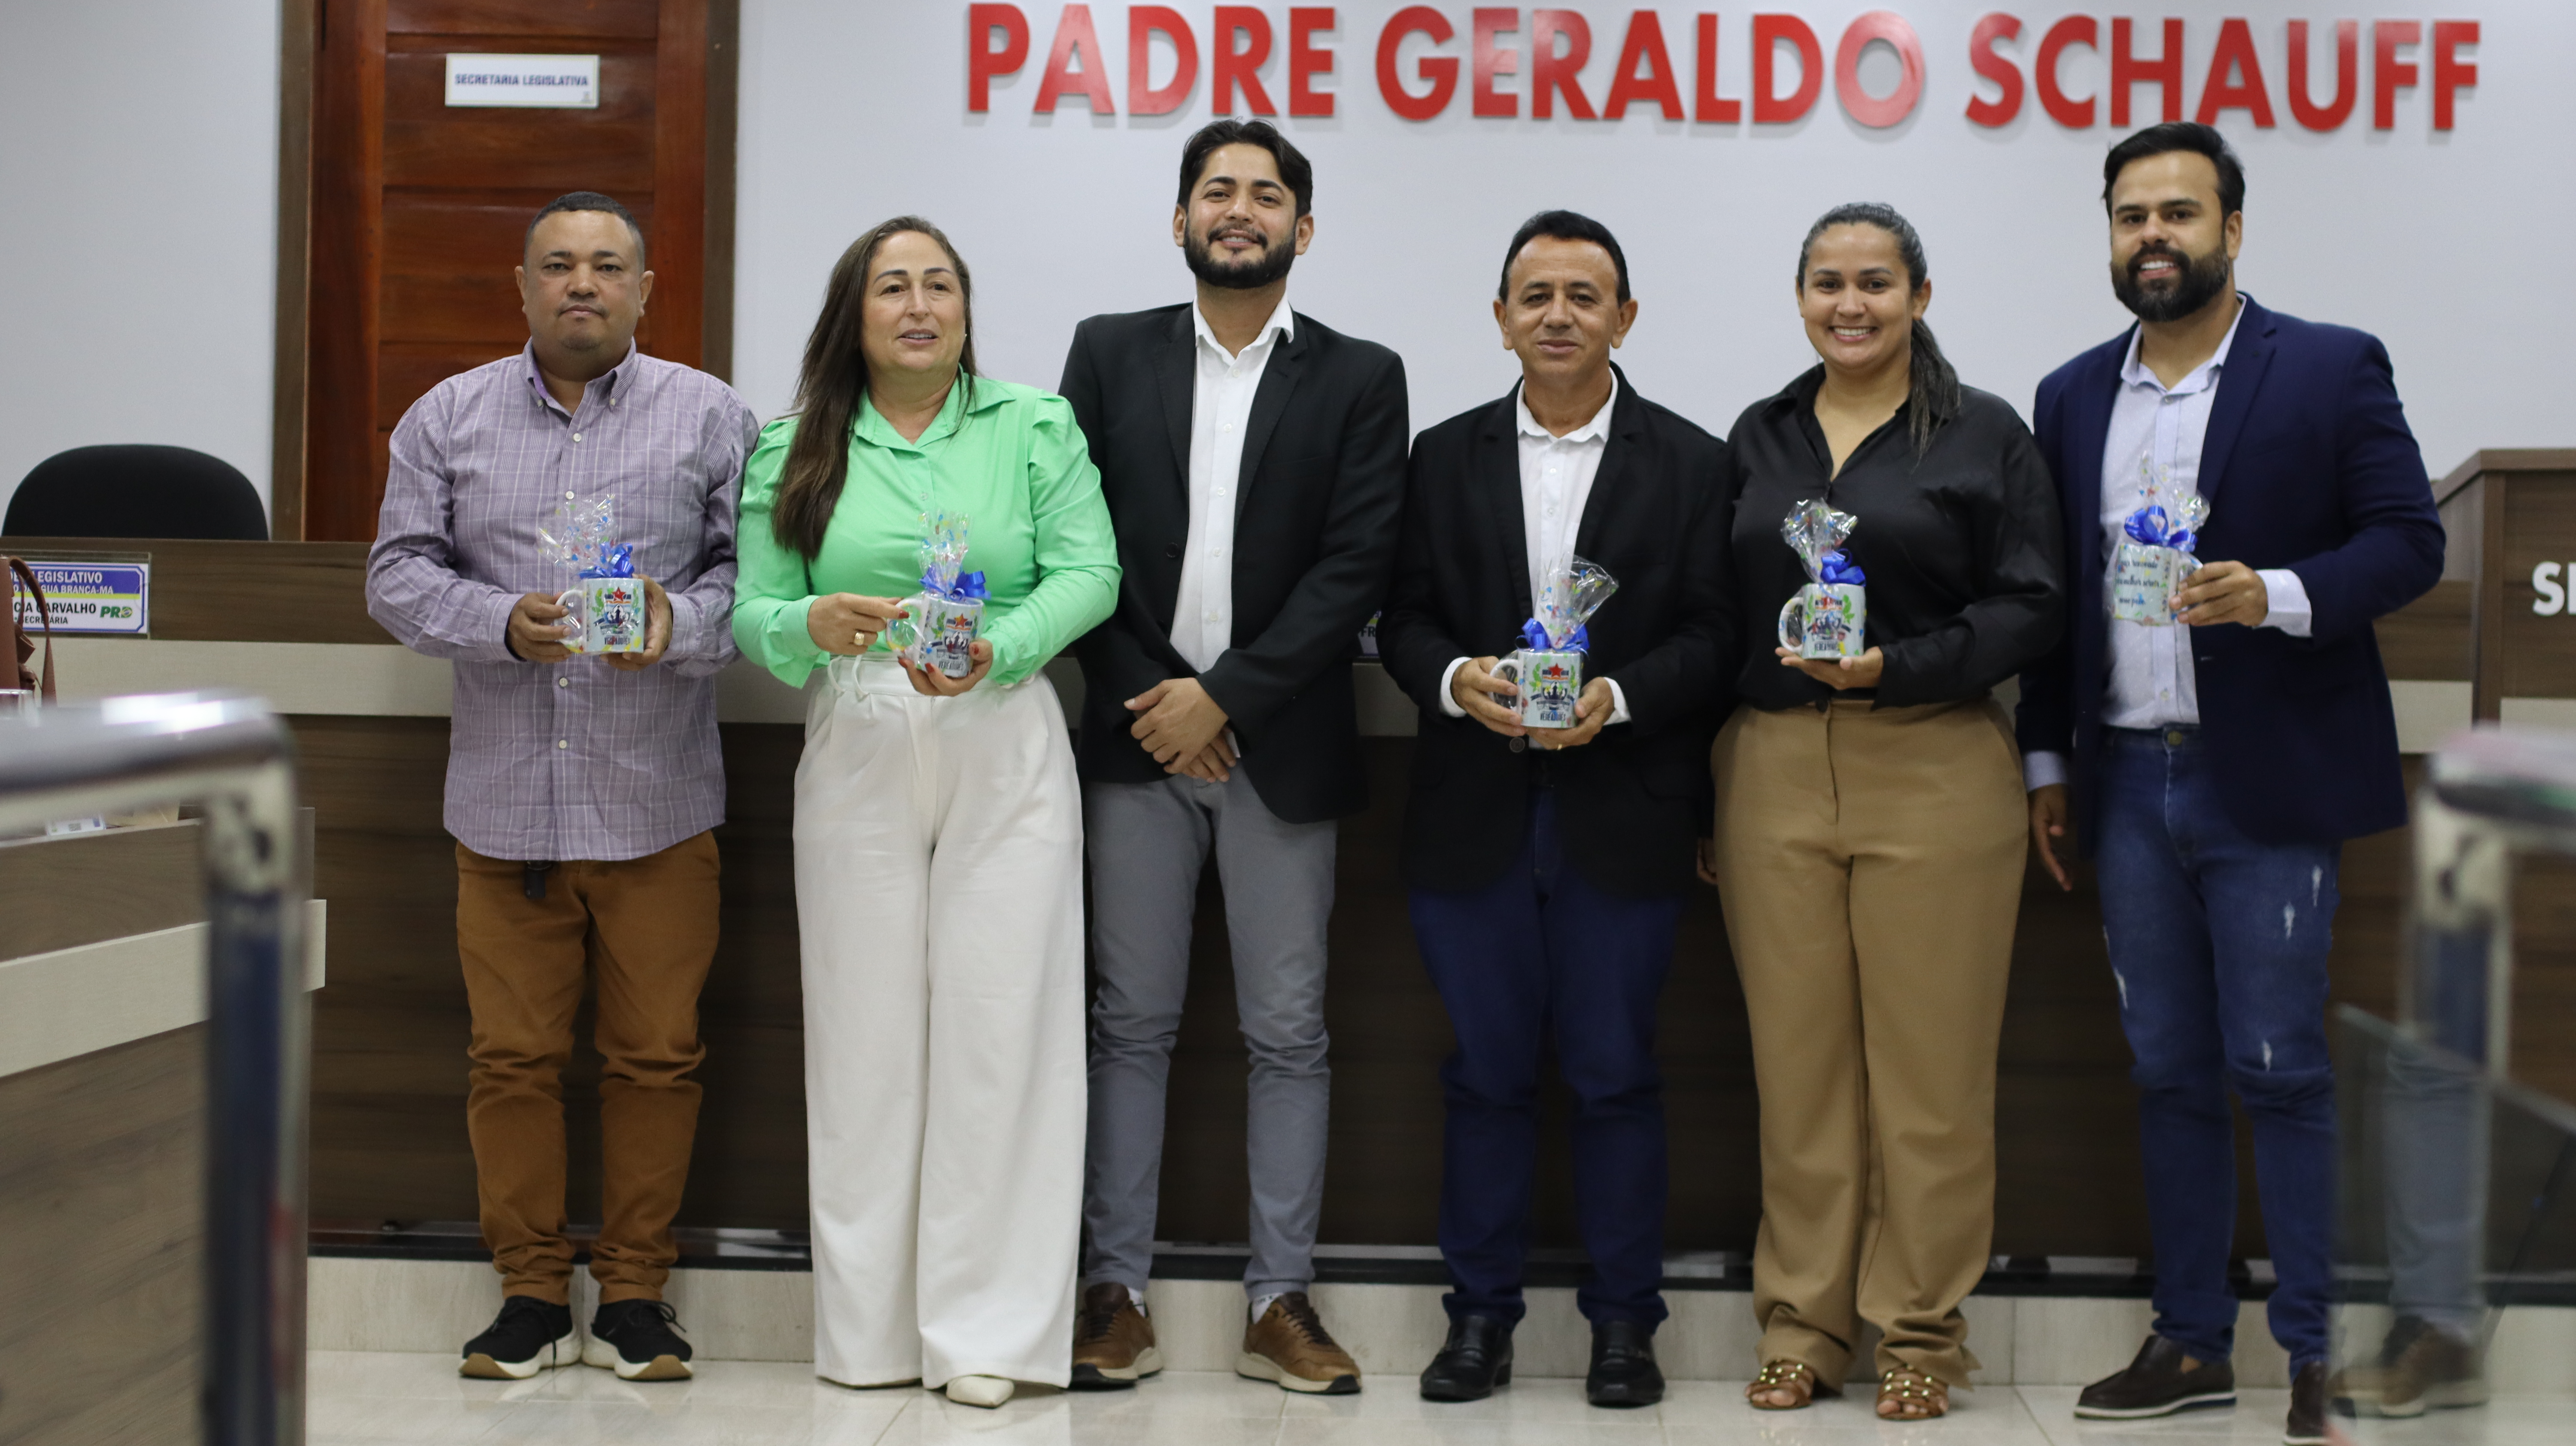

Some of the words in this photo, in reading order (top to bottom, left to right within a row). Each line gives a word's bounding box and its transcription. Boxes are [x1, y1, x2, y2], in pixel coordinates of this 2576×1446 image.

[968, 3, 1336, 116] PADRE
[1375, 5, 1924, 127] GERALDO
[1965, 12, 2481, 132] SCHAUFF
[455, 74, 519, 85] SECRETARIA
[522, 75, 588, 85] LEGISLATIVA
[33, 571, 103, 584] EGISLATIVO
[40, 584, 59, 593] GUA
[61, 584, 114, 595] BRANCA-MA
[24, 614, 68, 624] ECREÁRIA
